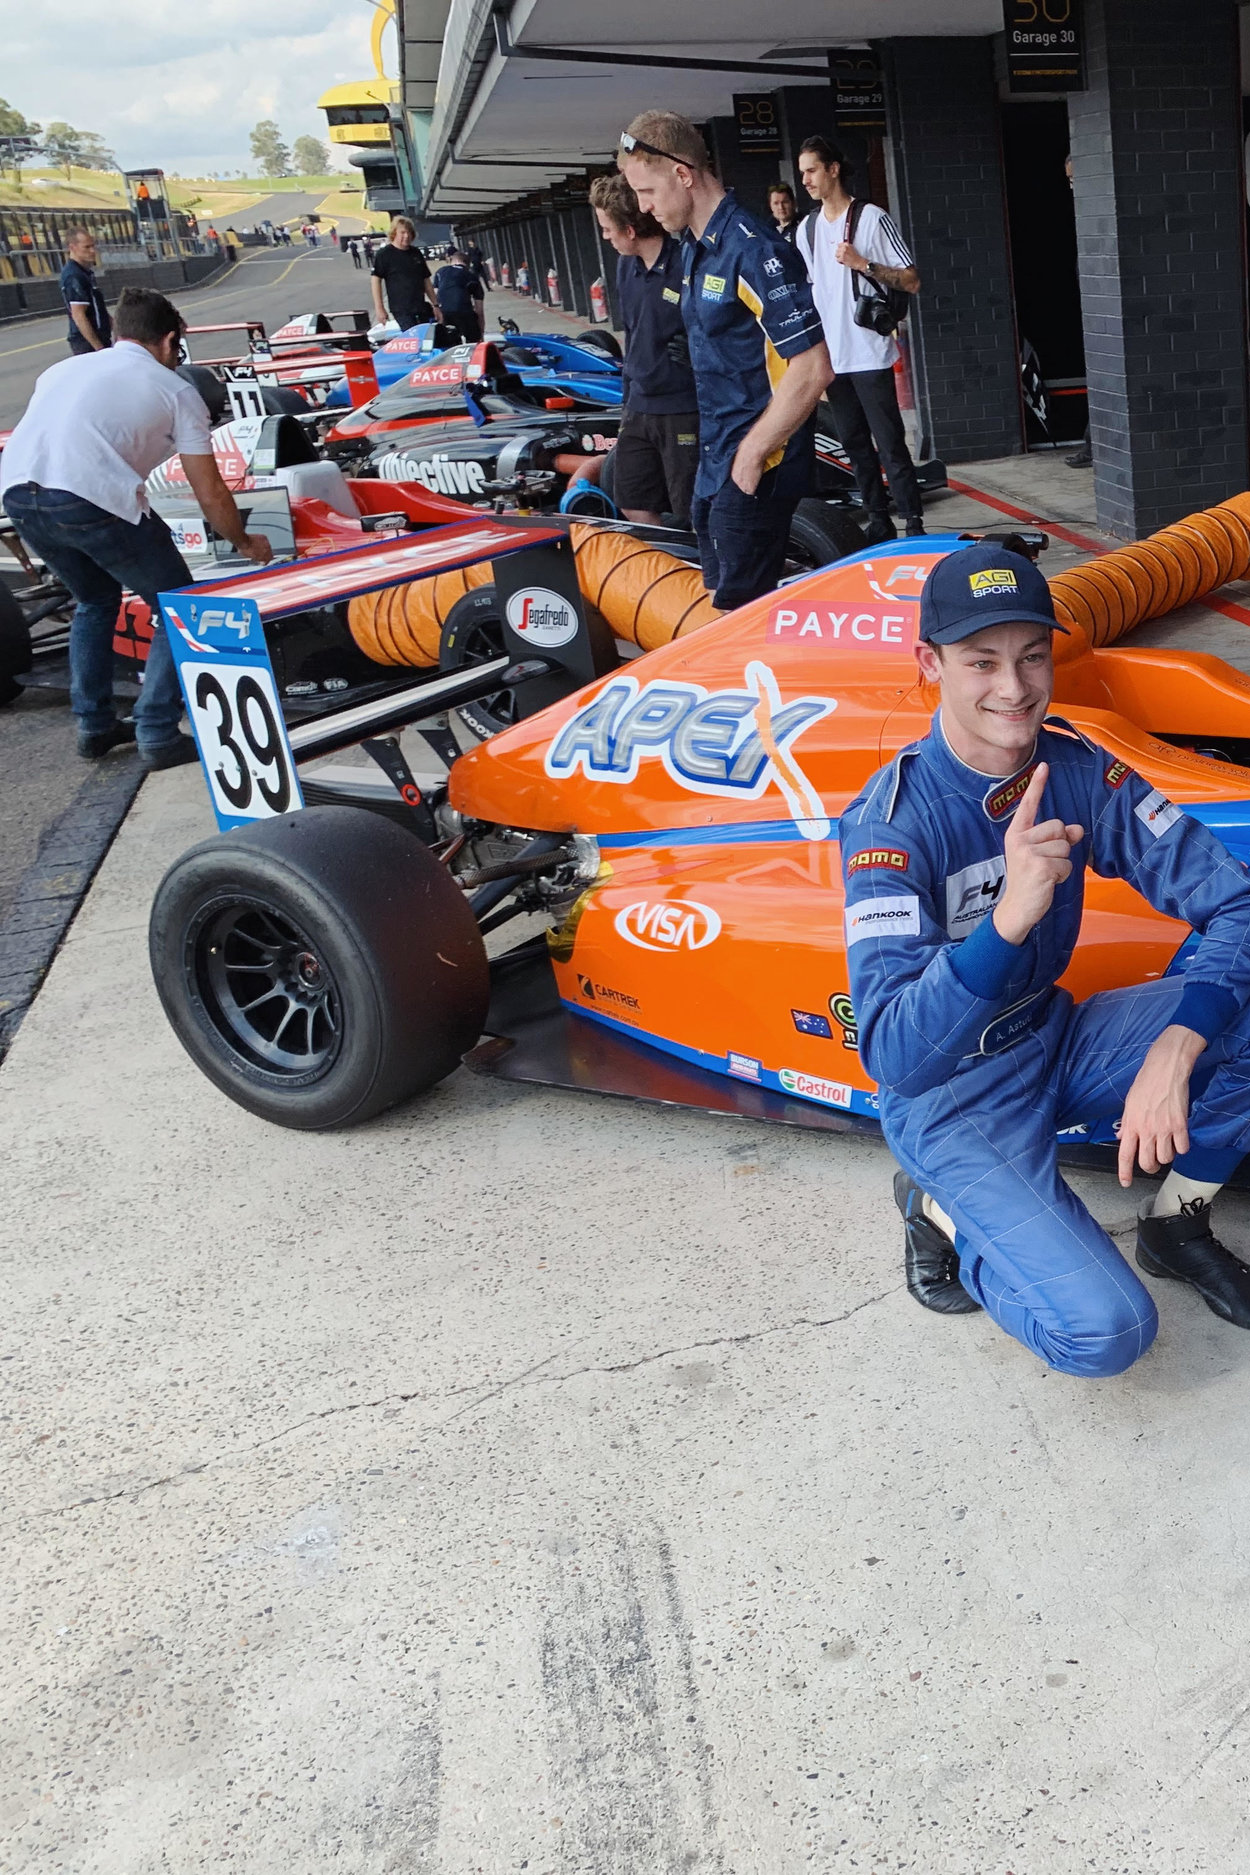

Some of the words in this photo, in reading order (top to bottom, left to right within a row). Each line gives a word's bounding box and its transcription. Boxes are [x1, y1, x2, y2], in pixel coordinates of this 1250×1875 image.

[1013, 30, 1057, 46] Garage
[1060, 30, 1075, 43] 30
[739, 101, 774, 124] 28
[837, 94, 870, 105] Garage
[872, 94, 882, 103] 29
[385, 340, 417, 351] PAYCE
[412, 367, 460, 383] PAYCE
[232, 391, 262, 418] 11
[973, 585, 1018, 598] SPORT
[975, 571, 1014, 586] AGI
[198, 610, 252, 640] F4
[518, 598, 569, 630] Segafredo
[775, 610, 905, 643] PAYCE
[196, 672, 291, 813] 39
[545, 661, 837, 840] APEX
[956, 875, 1005, 913] F4
[637, 901, 696, 950] VISA
[595, 984, 641, 1010] CARTREK
[797, 1076, 847, 1104] Castrol
